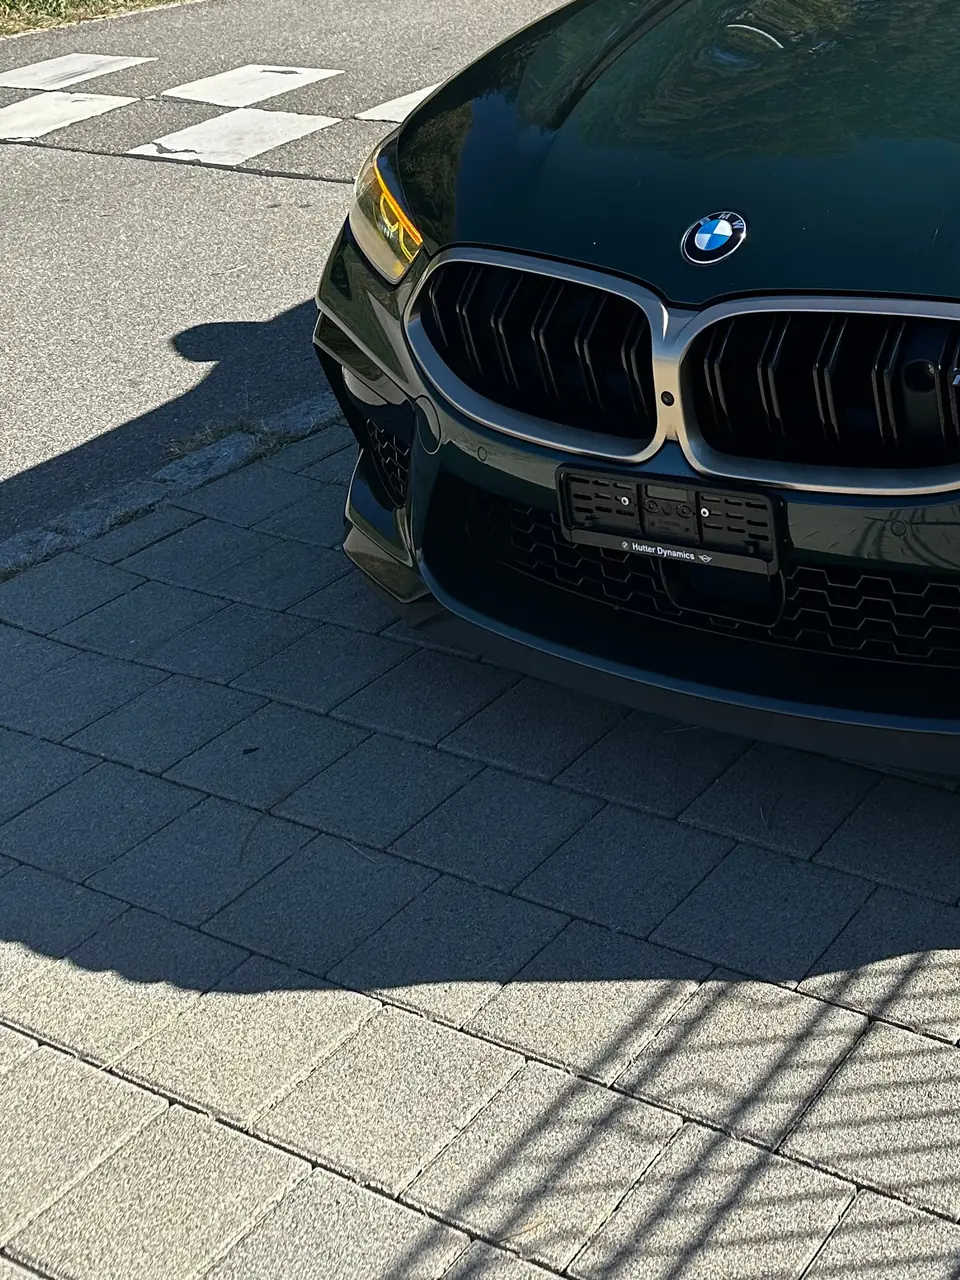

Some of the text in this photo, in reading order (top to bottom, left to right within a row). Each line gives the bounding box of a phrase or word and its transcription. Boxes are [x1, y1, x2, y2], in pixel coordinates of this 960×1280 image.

[699, 213, 744, 229] BMW
[632, 542, 695, 560] Hutter Dynamics
